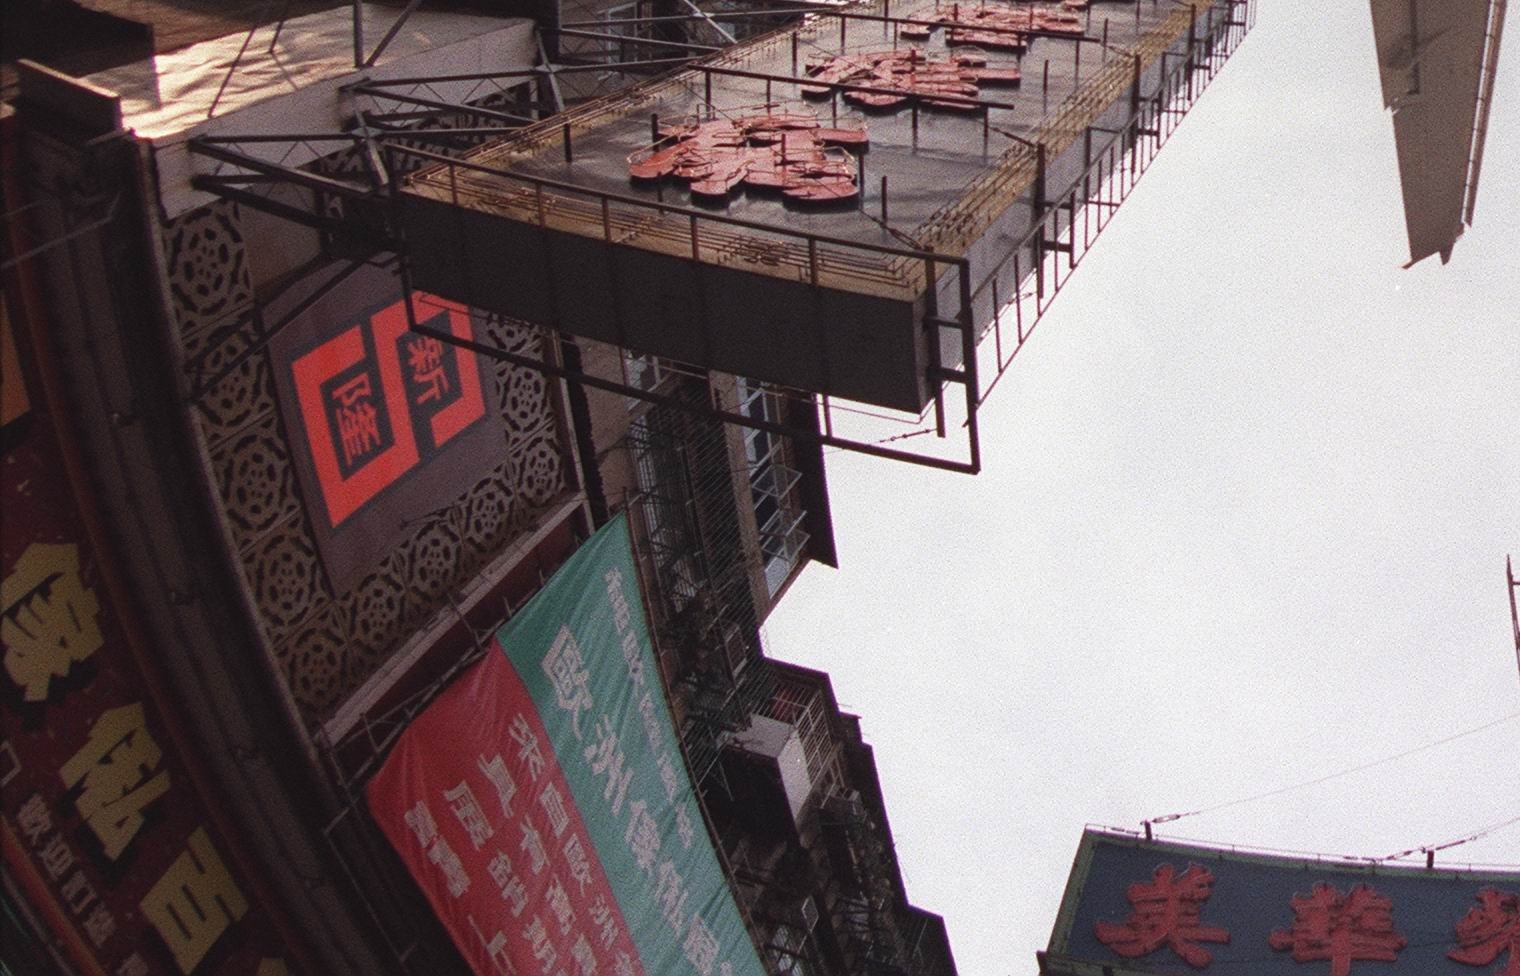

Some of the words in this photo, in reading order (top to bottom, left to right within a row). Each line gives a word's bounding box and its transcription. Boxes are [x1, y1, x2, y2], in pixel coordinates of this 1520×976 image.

[541, 624, 733, 976] 歐洲傢俬展
